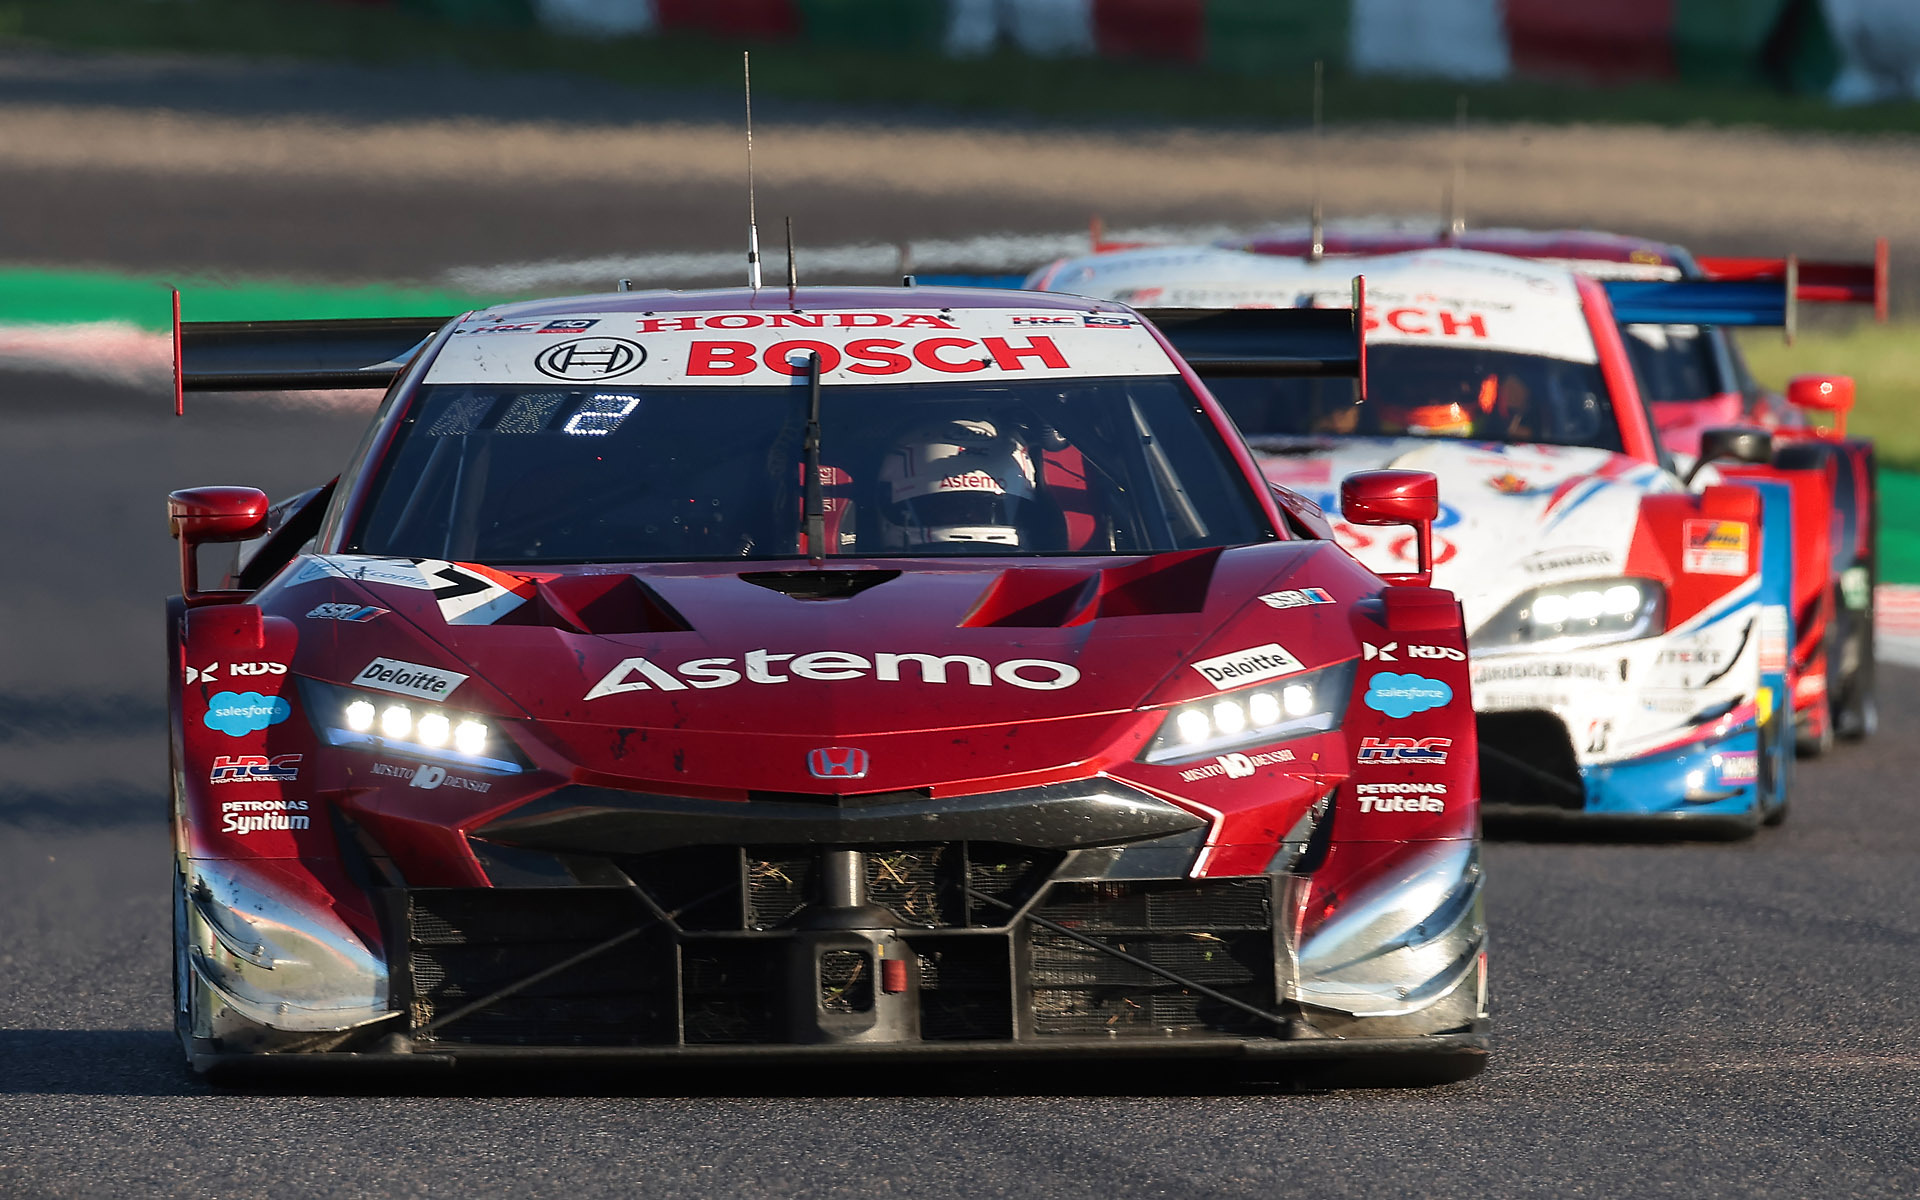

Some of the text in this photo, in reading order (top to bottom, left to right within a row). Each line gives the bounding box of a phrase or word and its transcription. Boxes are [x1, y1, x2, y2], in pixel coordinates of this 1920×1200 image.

[636, 313, 961, 333] HONDA
[1012, 316, 1076, 325] HRC
[1089, 317, 1124, 326] 40
[685, 335, 1072, 377] BOSCH
[581, 647, 1082, 702] Astemo
[1375, 687, 1445, 700] salesforce
[215, 704, 283, 719] salesforce
[1357, 736, 1452, 760] HRC
[210, 753, 303, 779] HRC
[1356, 783, 1448, 795] PETRONAS
[222, 800, 310, 812] PETRONAS
[1357, 795, 1445, 813] Tutela
[221, 811, 310, 835] Syntium
